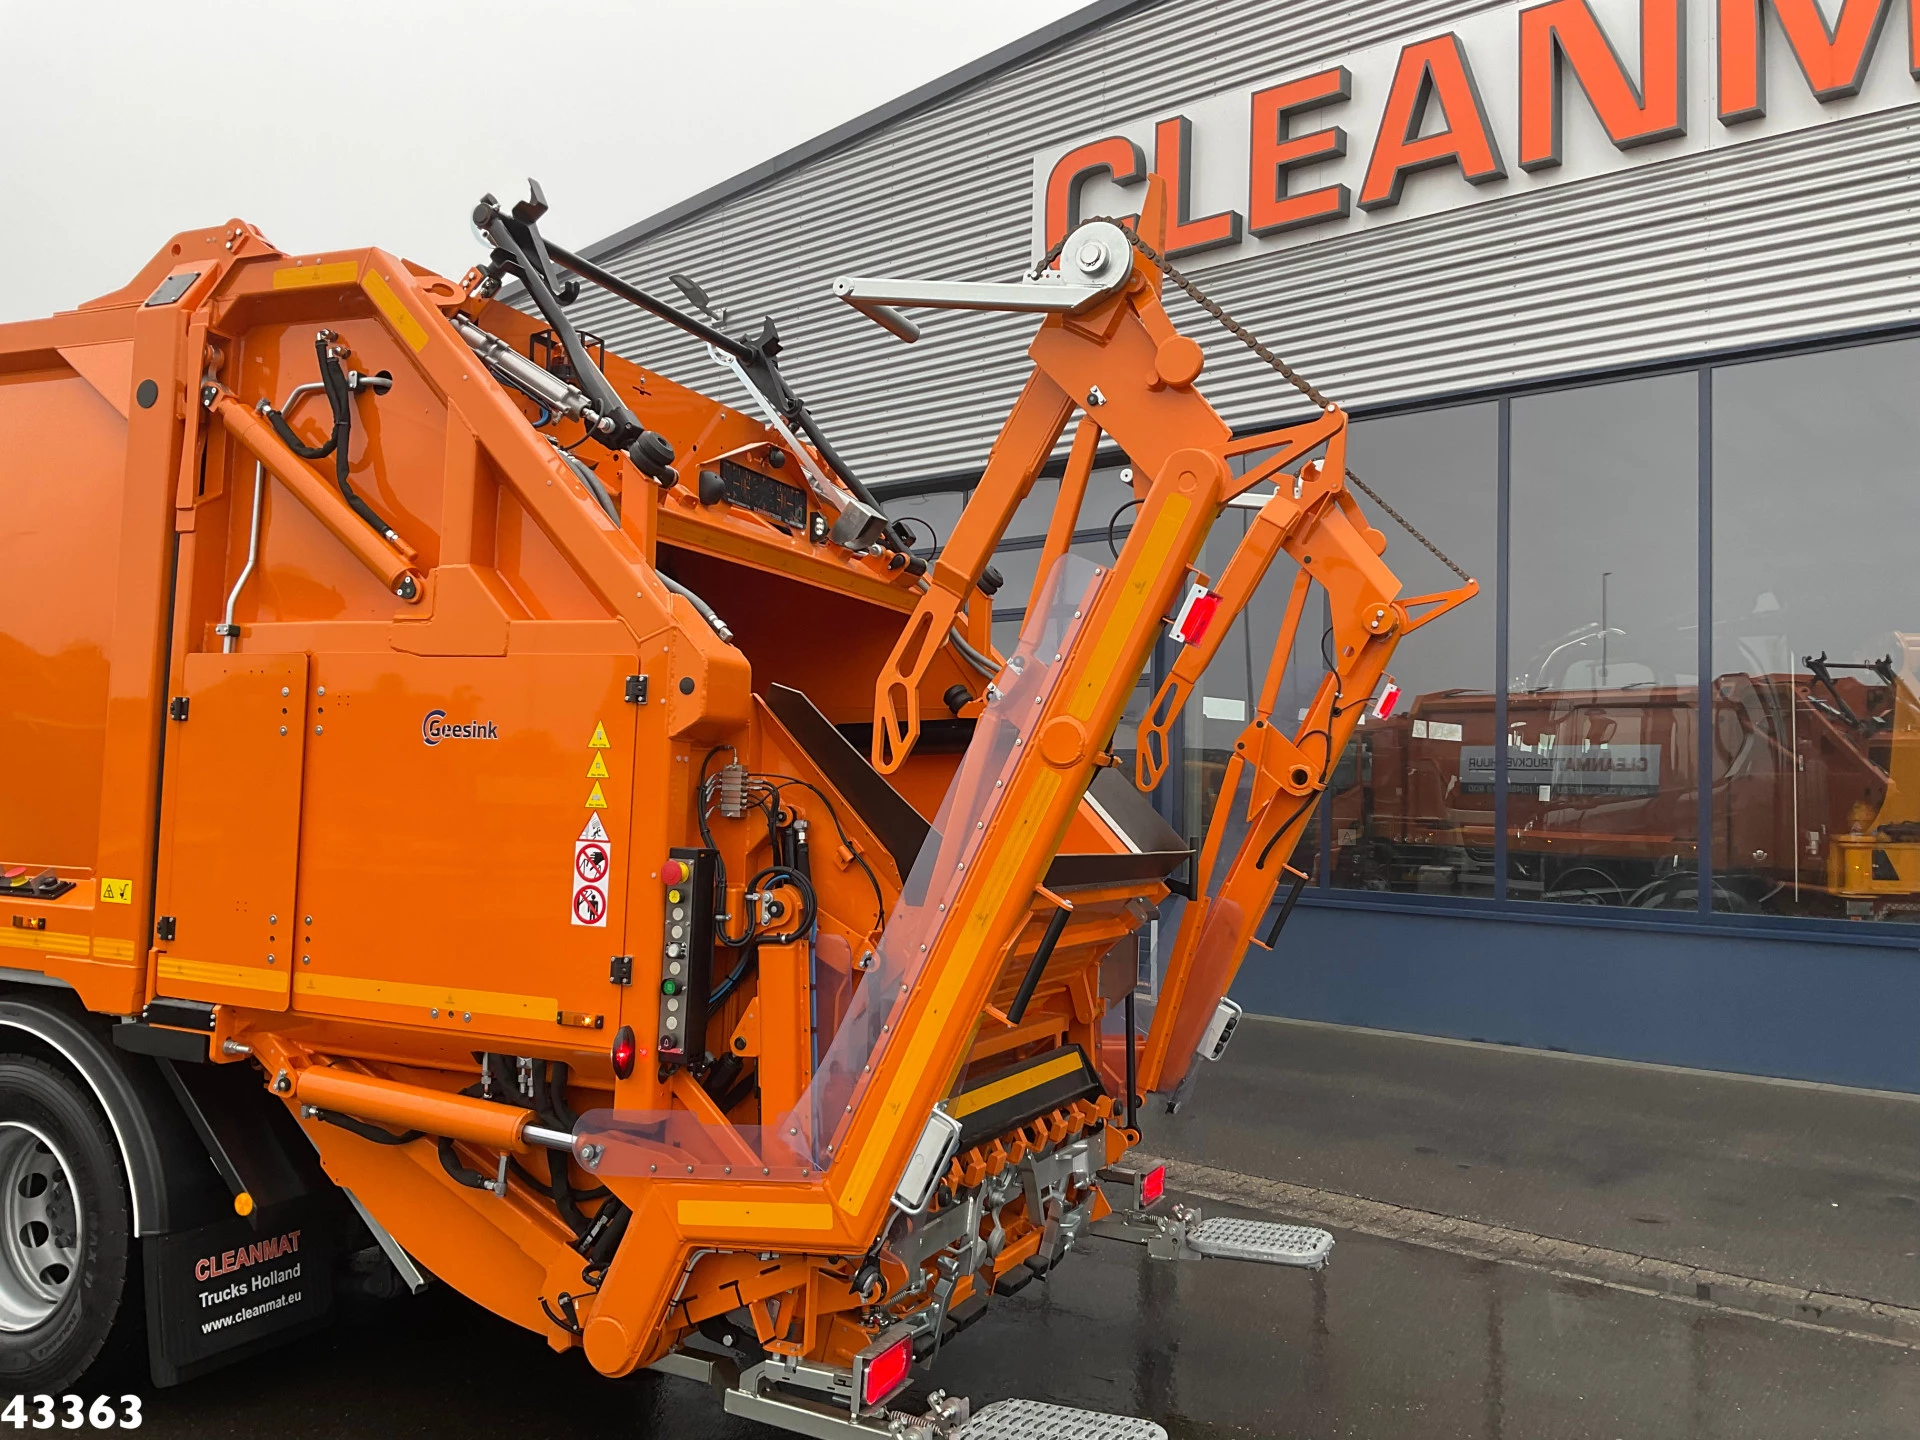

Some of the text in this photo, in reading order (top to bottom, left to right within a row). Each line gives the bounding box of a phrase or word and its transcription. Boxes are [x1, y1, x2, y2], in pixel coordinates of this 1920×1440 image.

[1045, 0, 1920, 270] CLEANM
[424, 713, 498, 742] Geesink
[195, 1230, 301, 1282] CLEANMAT
[198, 1262, 301, 1308] Trucks Holland
[201, 1291, 302, 1334] www.cleanmat.eu
